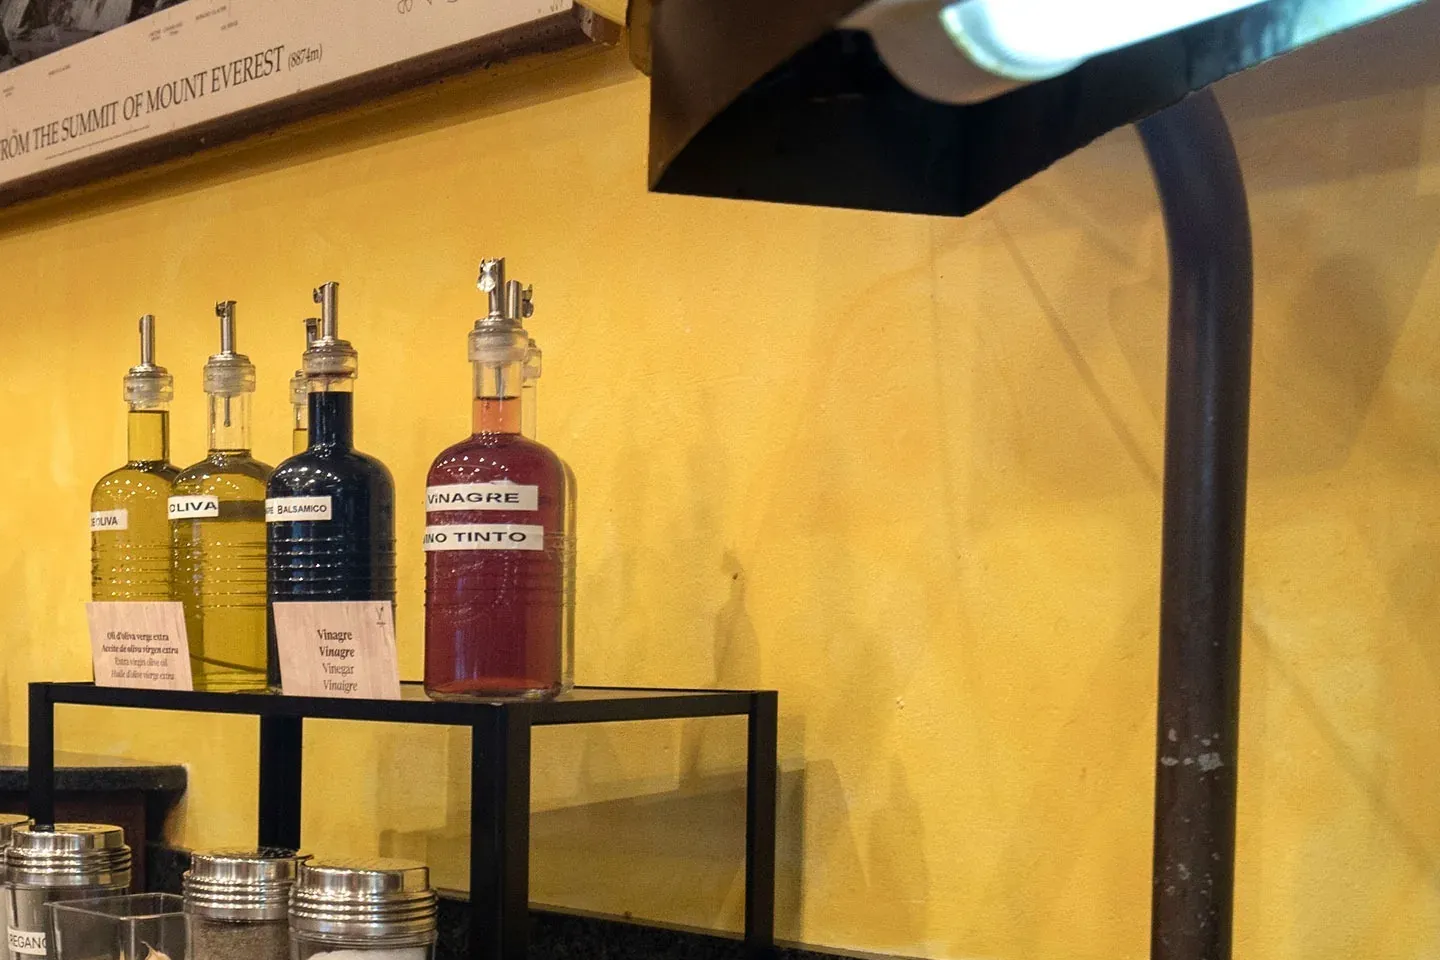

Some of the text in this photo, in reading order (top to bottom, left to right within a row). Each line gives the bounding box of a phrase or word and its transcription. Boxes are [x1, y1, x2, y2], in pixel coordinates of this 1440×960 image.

[33, 121, 59, 150] THE
[61, 101, 119, 142] SUMMIT
[123, 92, 144, 121] OF
[146, 71, 208, 114] MOUNT
[211, 45, 285, 94] EVEREST
[169, 501, 217, 513] OLIVA
[277, 504, 327, 515] BALSAMICO
[453, 532, 526, 542] TINTO
[153, 633, 169, 641] extra
[317, 629, 353, 643] Vinagre
[119, 644, 127, 653] de
[127, 644, 142, 654] oliva
[162, 646, 179, 654] extra
[319, 646, 355, 660] Vinagre
[322, 662, 354, 677] Vinegar
[323, 679, 358, 694] Vinaigre
